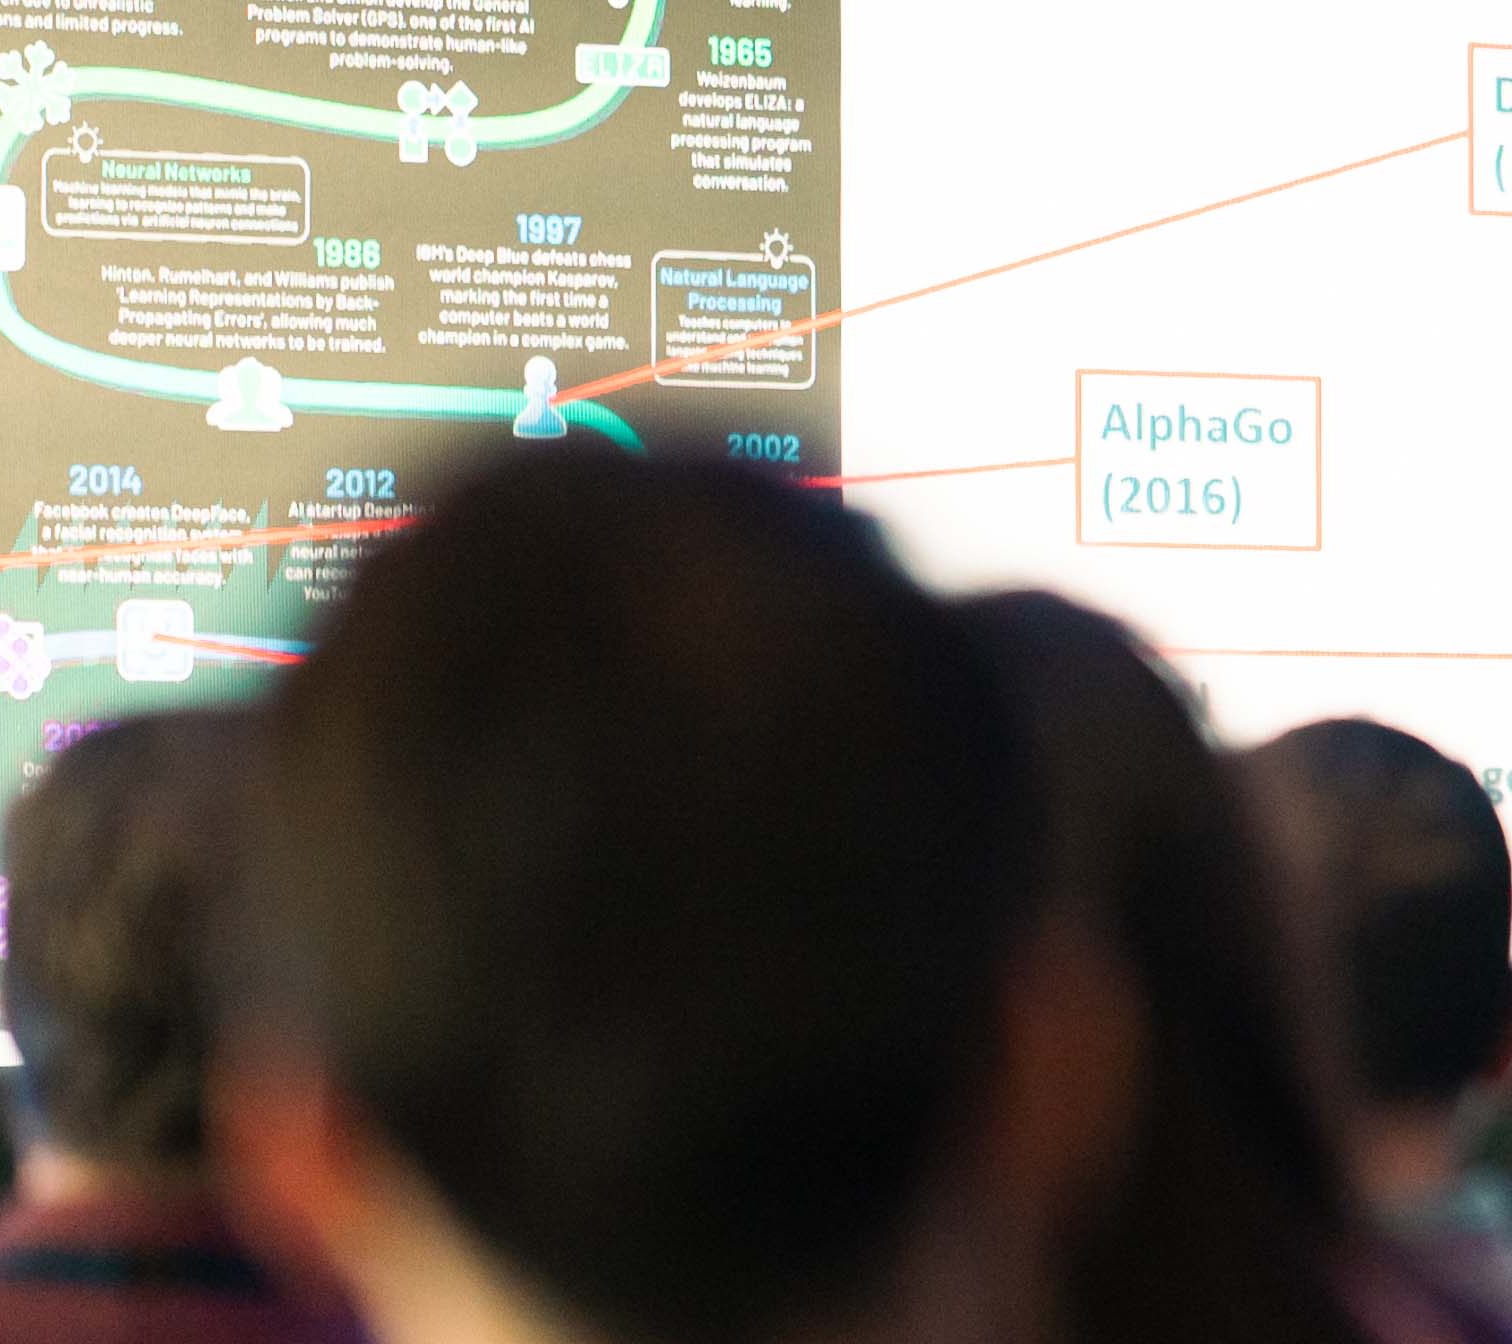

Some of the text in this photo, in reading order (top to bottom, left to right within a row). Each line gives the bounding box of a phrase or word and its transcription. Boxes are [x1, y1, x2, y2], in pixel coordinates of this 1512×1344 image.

[708, 34, 773, 68] 1965
[679, 91, 743, 111] develops
[795, 98, 805, 112] a
[682, 112, 800, 135] natural language
[671, 133, 812, 155] processing program
[101, 159, 252, 184] Neural Networks
[691, 151, 720, 169] that
[516, 213, 582, 245] 1997
[456, 245, 494, 266] Deep
[496, 246, 530, 265] Blue
[429, 267, 471, 283] world
[473, 268, 545, 288] champion
[660, 267, 809, 294] Natural Language
[440, 288, 609, 308] marking the first time a
[687, 291, 782, 316] Processing
[439, 310, 610, 329] computer beats a world
[418, 328, 629, 352] champion in a complex game.
[1100, 400, 1297, 454] AlphaGo
[726, 431, 801, 463] 2002
[68, 463, 143, 497] 2014
[326, 466, 396, 499] 2012
[1100, 471, 1246, 527] (2016)
